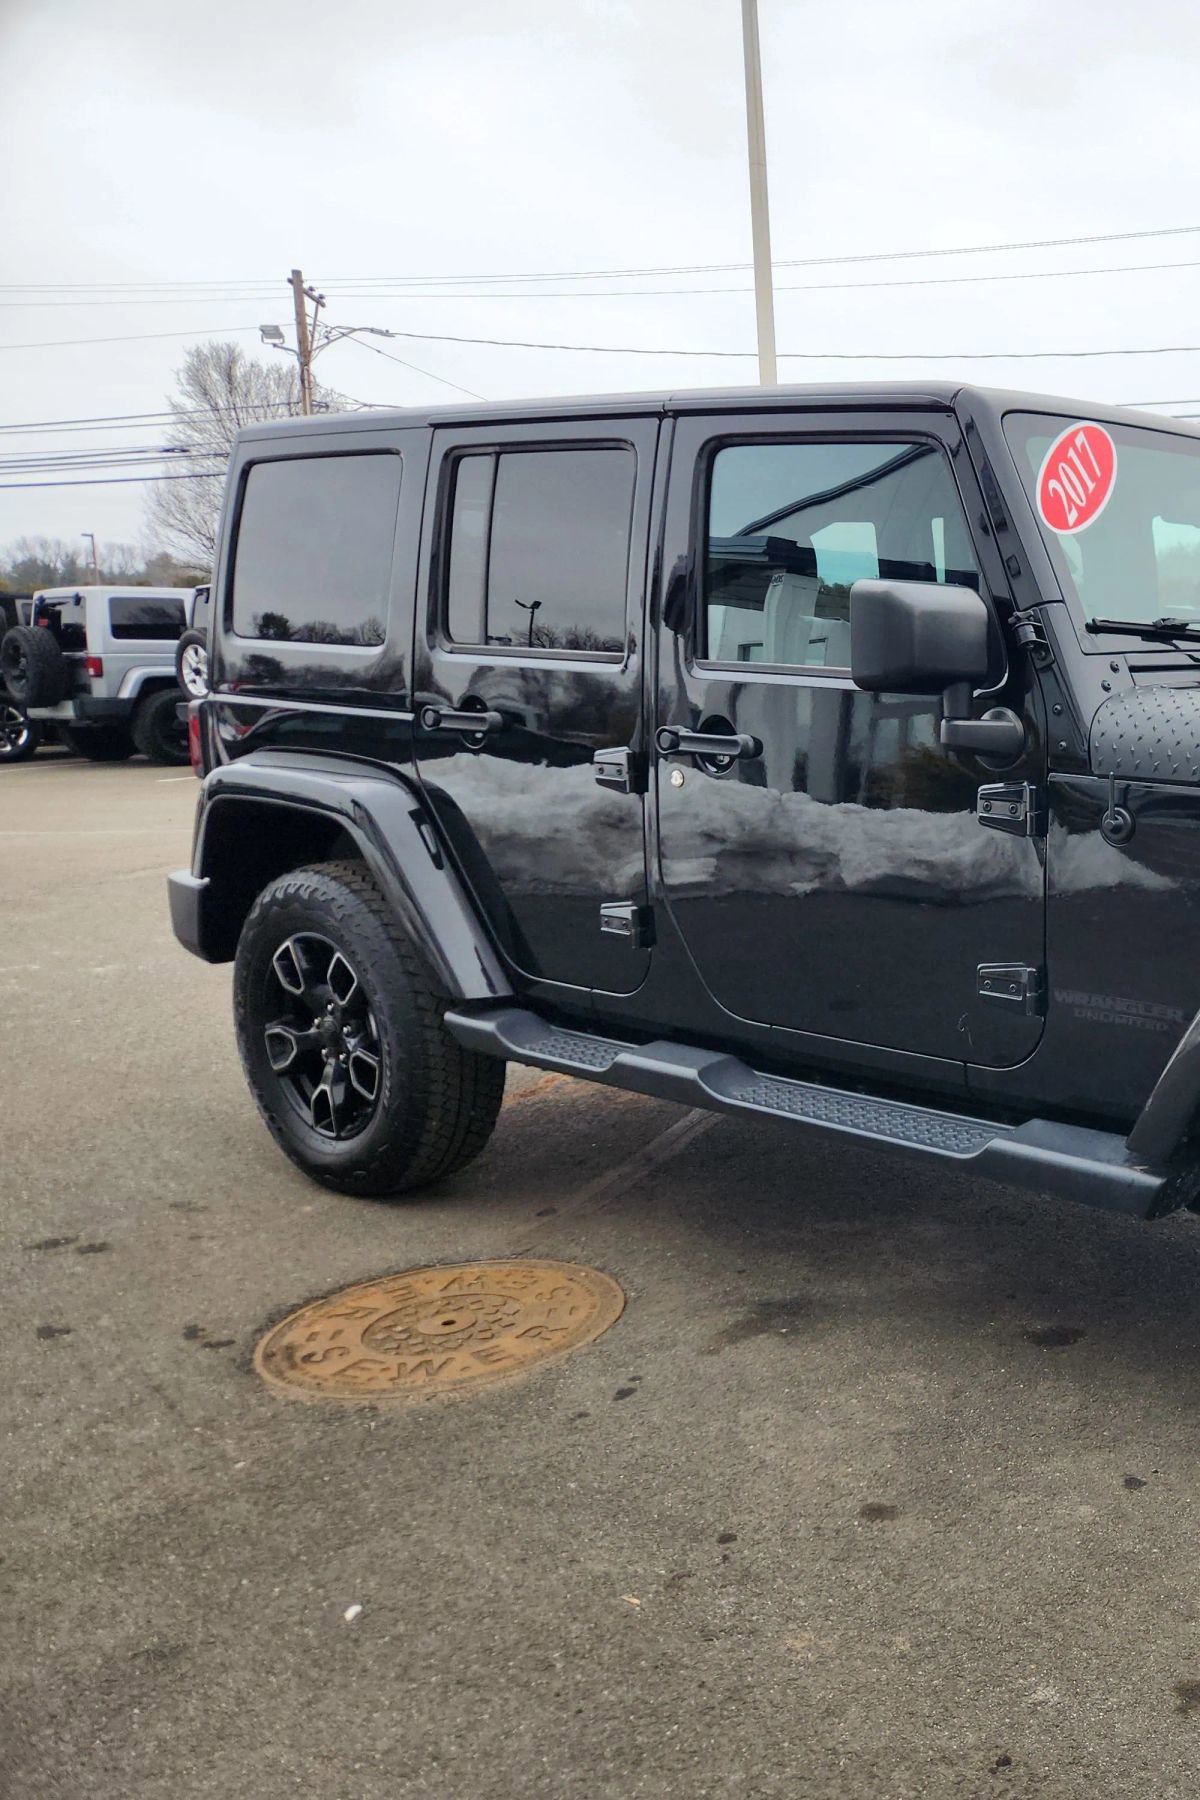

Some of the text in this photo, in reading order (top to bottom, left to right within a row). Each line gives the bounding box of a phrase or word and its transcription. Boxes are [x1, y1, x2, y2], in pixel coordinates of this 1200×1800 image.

[1047, 429, 1102, 528] 2017
[1053, 987, 1185, 1023] WRANGLER
[299, 1324, 569, 1380] SEWER
